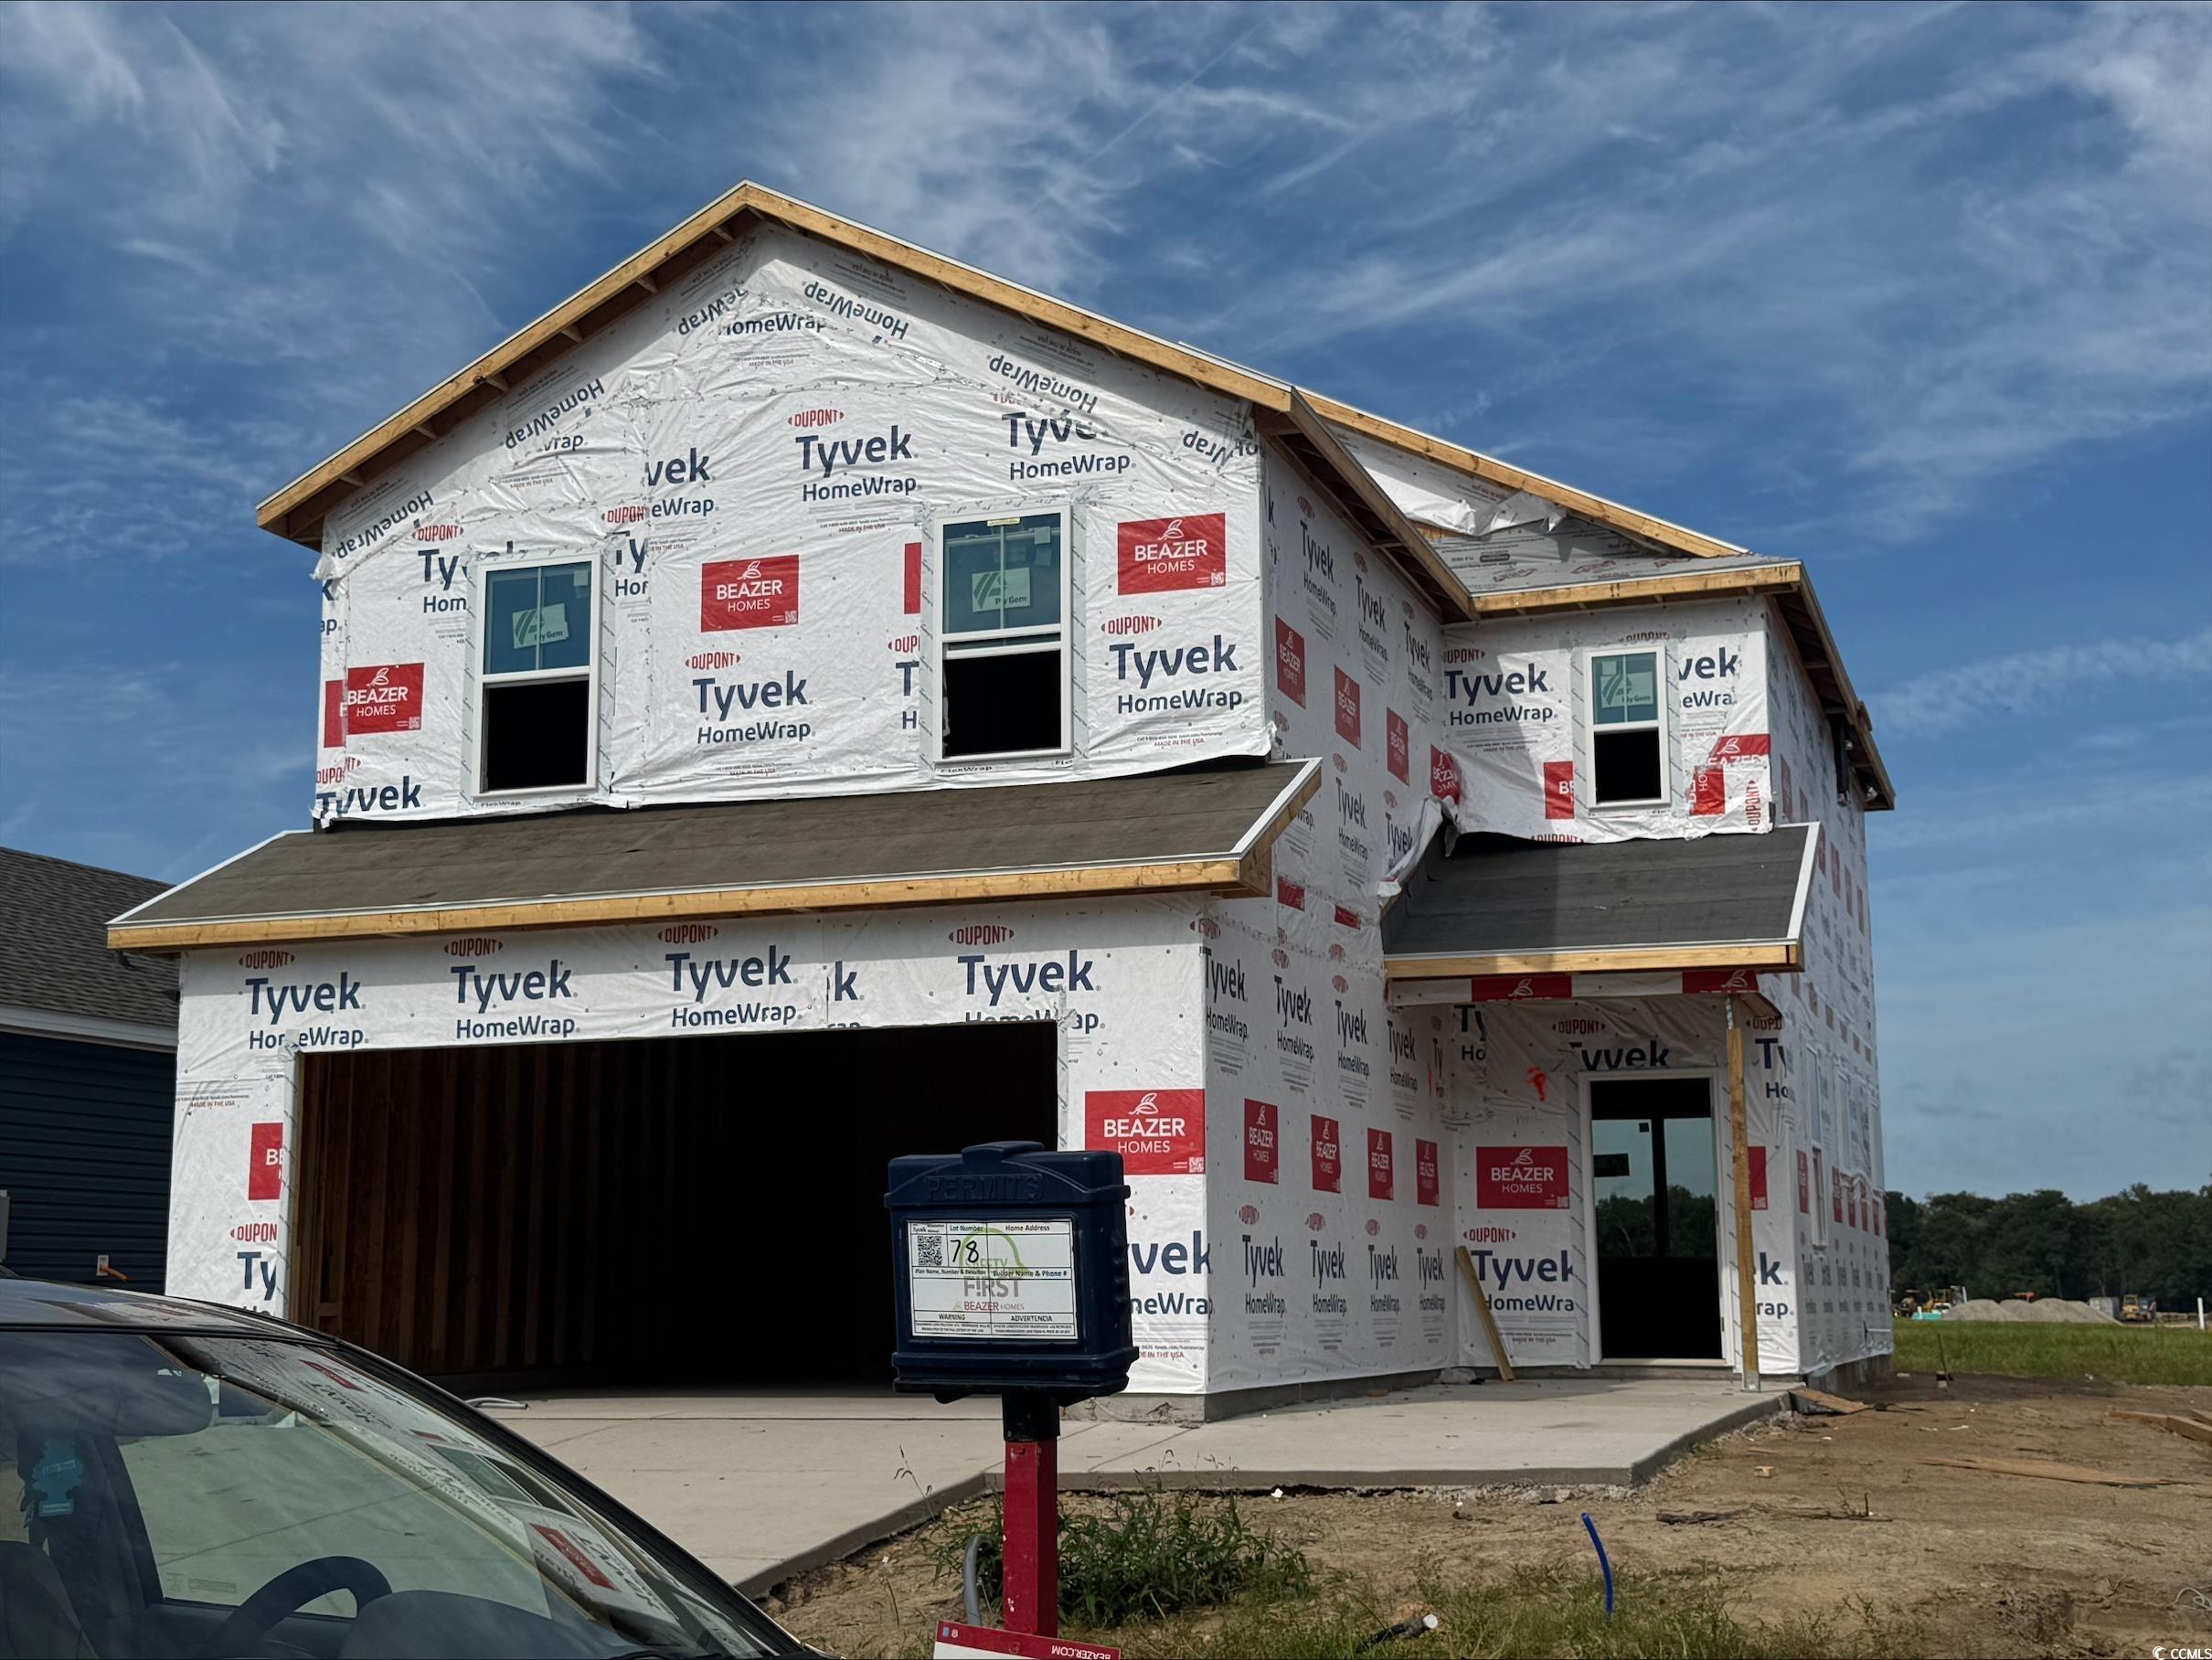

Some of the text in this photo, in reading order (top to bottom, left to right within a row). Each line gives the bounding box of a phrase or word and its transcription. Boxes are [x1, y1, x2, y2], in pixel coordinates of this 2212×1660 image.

[804, 282, 909, 339] HomeWrap
[989, 354, 1098, 413] HomeWrap
[505, 378, 605, 450] HomeWrap
[794, 410, 839, 428] DUPONT
[795, 425, 913, 479] Tyvek
[1010, 454, 1131, 481] HomeWrap
[803, 476, 917, 502] HomeWrap
[335, 489, 434, 559] HomeWrap
[417, 525, 460, 542] DUPONT
[1134, 538, 1207, 562] BEAZER
[1300, 519, 1335, 585] Tyvek
[1147, 559, 1196, 575] HOMES
[717, 580, 783, 601] BEAZER
[1356, 574, 1387, 633] Tyvek
[728, 598, 771, 612] HOMES
[1108, 616, 1156, 635] DUPONT
[692, 652, 735, 670] DUPONT
[1404, 621, 1431, 674] Tyvek
[1444, 649, 1480, 664] UPONT
[1109, 634, 1237, 689] Tyvek
[348, 686, 409, 705] BEAZER
[693, 670, 807, 721] Tyvek
[1444, 663, 1549, 707] Tyvek
[356, 704, 396, 718] HOMES
[1118, 687, 1243, 714] HomeWrap
[1451, 705, 1554, 726] HomeWrap
[697, 721, 812, 745] HomeWrap
[1335, 776, 1367, 830] Tyvek
[1745, 786, 1761, 826] DUPONT
[452, 938, 495, 957] DUPONT
[665, 924, 711, 944] DUPONT
[956, 925, 1007, 945] DUPONT
[246, 950, 289, 969] DUPONT
[451, 959, 572, 1015] Tyvek
[665, 945, 792, 1003] Tyvek
[957, 950, 1094, 1006] Tyvek
[1199, 946, 1246, 1004] Tyvek
[245, 972, 361, 1026] Tyvek
[1274, 974, 1313, 1028] Tyvek
[456, 1015, 575, 1039] HomeWrap
[671, 1002, 797, 1028] HomeWrap
[1206, 1006, 1248, 1044] HomeWrap
[1335, 999, 1368, 1048] Tyvek
[1558, 1019, 1600, 1035] DUPONT
[1276, 1030, 1314, 1064] HomeWrap
[1387, 1020, 1417, 1065] Tyvek
[1337, 1049, 1370, 1081] HomeWrap
[1103, 1117, 1186, 1138] BEAZER
[1249, 1126, 1273, 1149] BEAZER
[1117, 1140, 1171, 1154] HOMES
[927, 1174, 1044, 1202] PERMITS
[1491, 1167, 1555, 1183] BEAZER
[1502, 1184, 1544, 1194] HOMES
[1469, 1227, 1511, 1243] DUPONT
[950, 1239, 980, 1263] 78
[1127, 1229, 1212, 1275] vek
[1242, 1234, 1284, 1288] Tyvek
[1311, 1239, 1345, 1290] Tyvek
[1368, 1244, 1398, 1291] Tyvek
[1417, 1247, 1444, 1291] Tyvek
[939, 1313, 966, 1321] WARNING
[963, 1301, 1025, 1312] BEAZER HOMES
[1245, 1291, 1285, 1318] HomeWrap
[1313, 1293, 1347, 1317] HomeWrap
[1011, 1314, 1053, 1323] ADVERTENCIA
